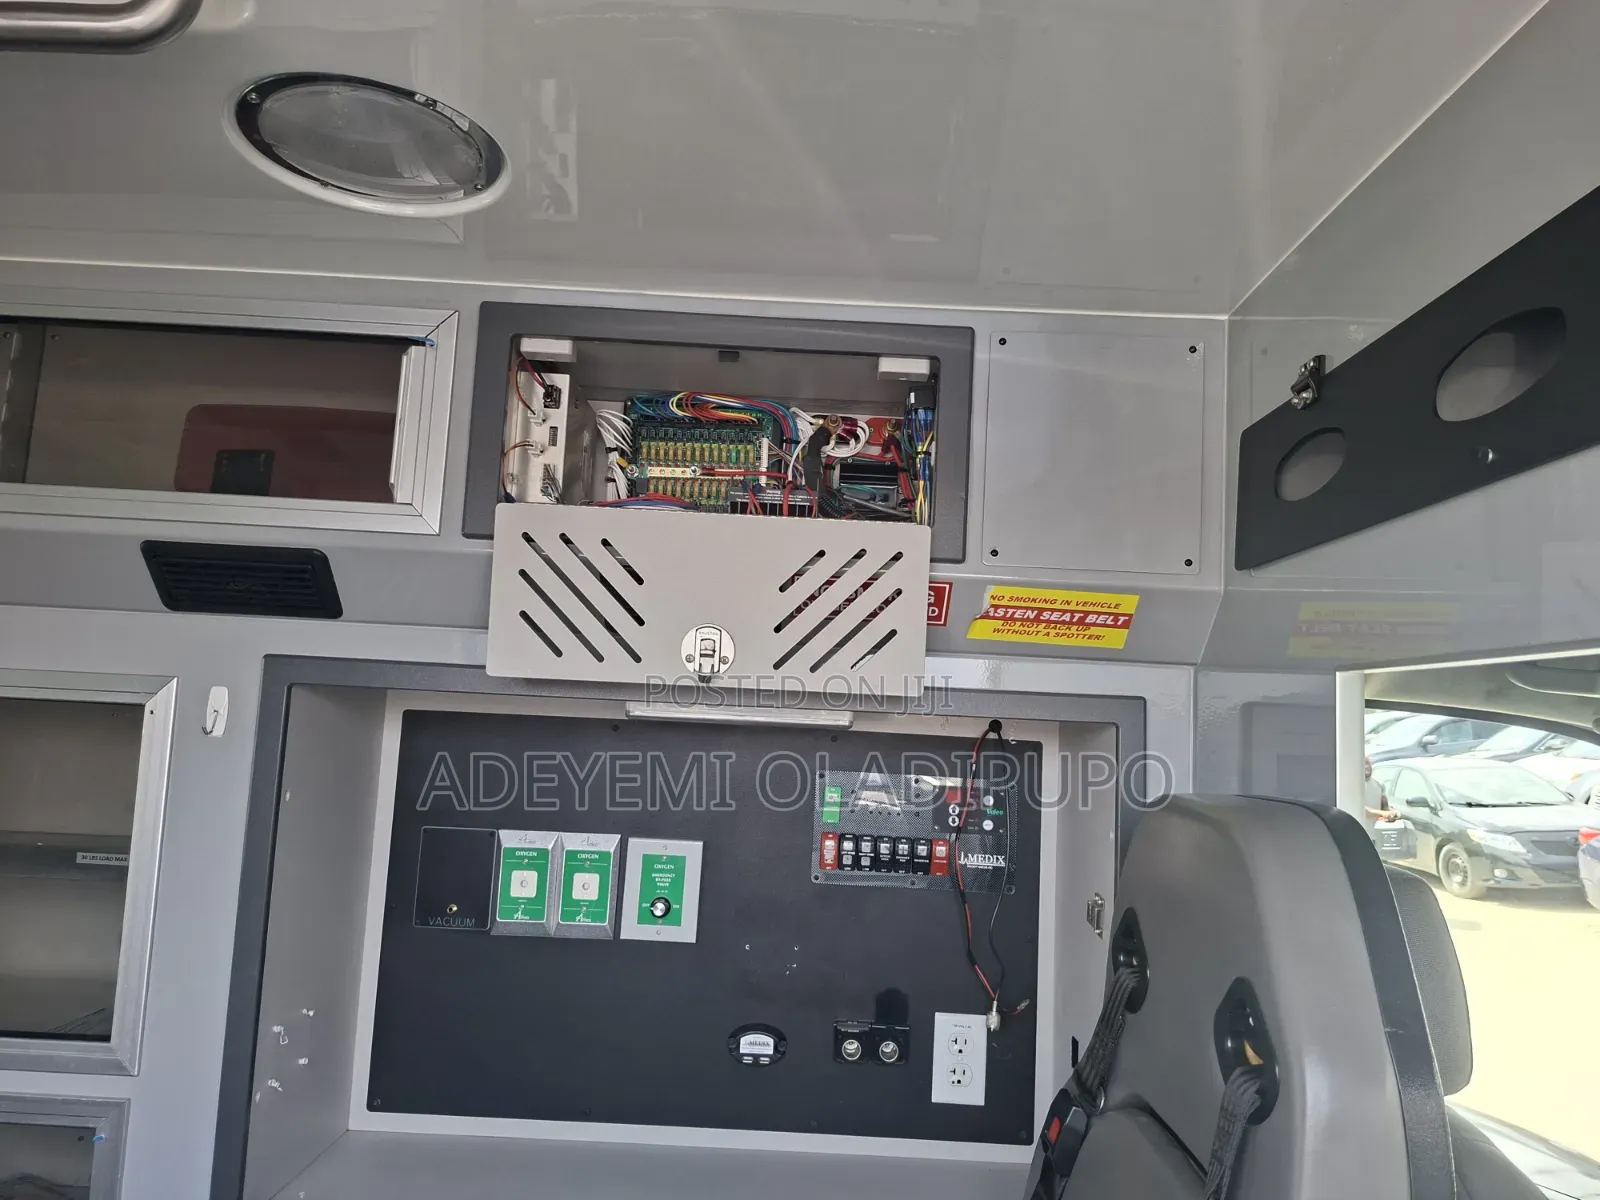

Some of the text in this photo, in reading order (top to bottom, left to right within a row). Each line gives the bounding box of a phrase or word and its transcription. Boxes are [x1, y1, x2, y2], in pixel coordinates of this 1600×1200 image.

[990, 594, 1122, 610] NO SMOKING IN VEHICLE
[984, 607, 1129, 626] ASTEN SEAT BELT
[1019, 622, 1041, 630] NOT
[1043, 624, 1071, 632] BACK
[992, 627, 1042, 637] WITHOUT
[1053, 632, 1105, 641] SPOTTER!
[967, 853, 1006, 865] MEDIX
[428, 916, 475, 927] VACUUM
